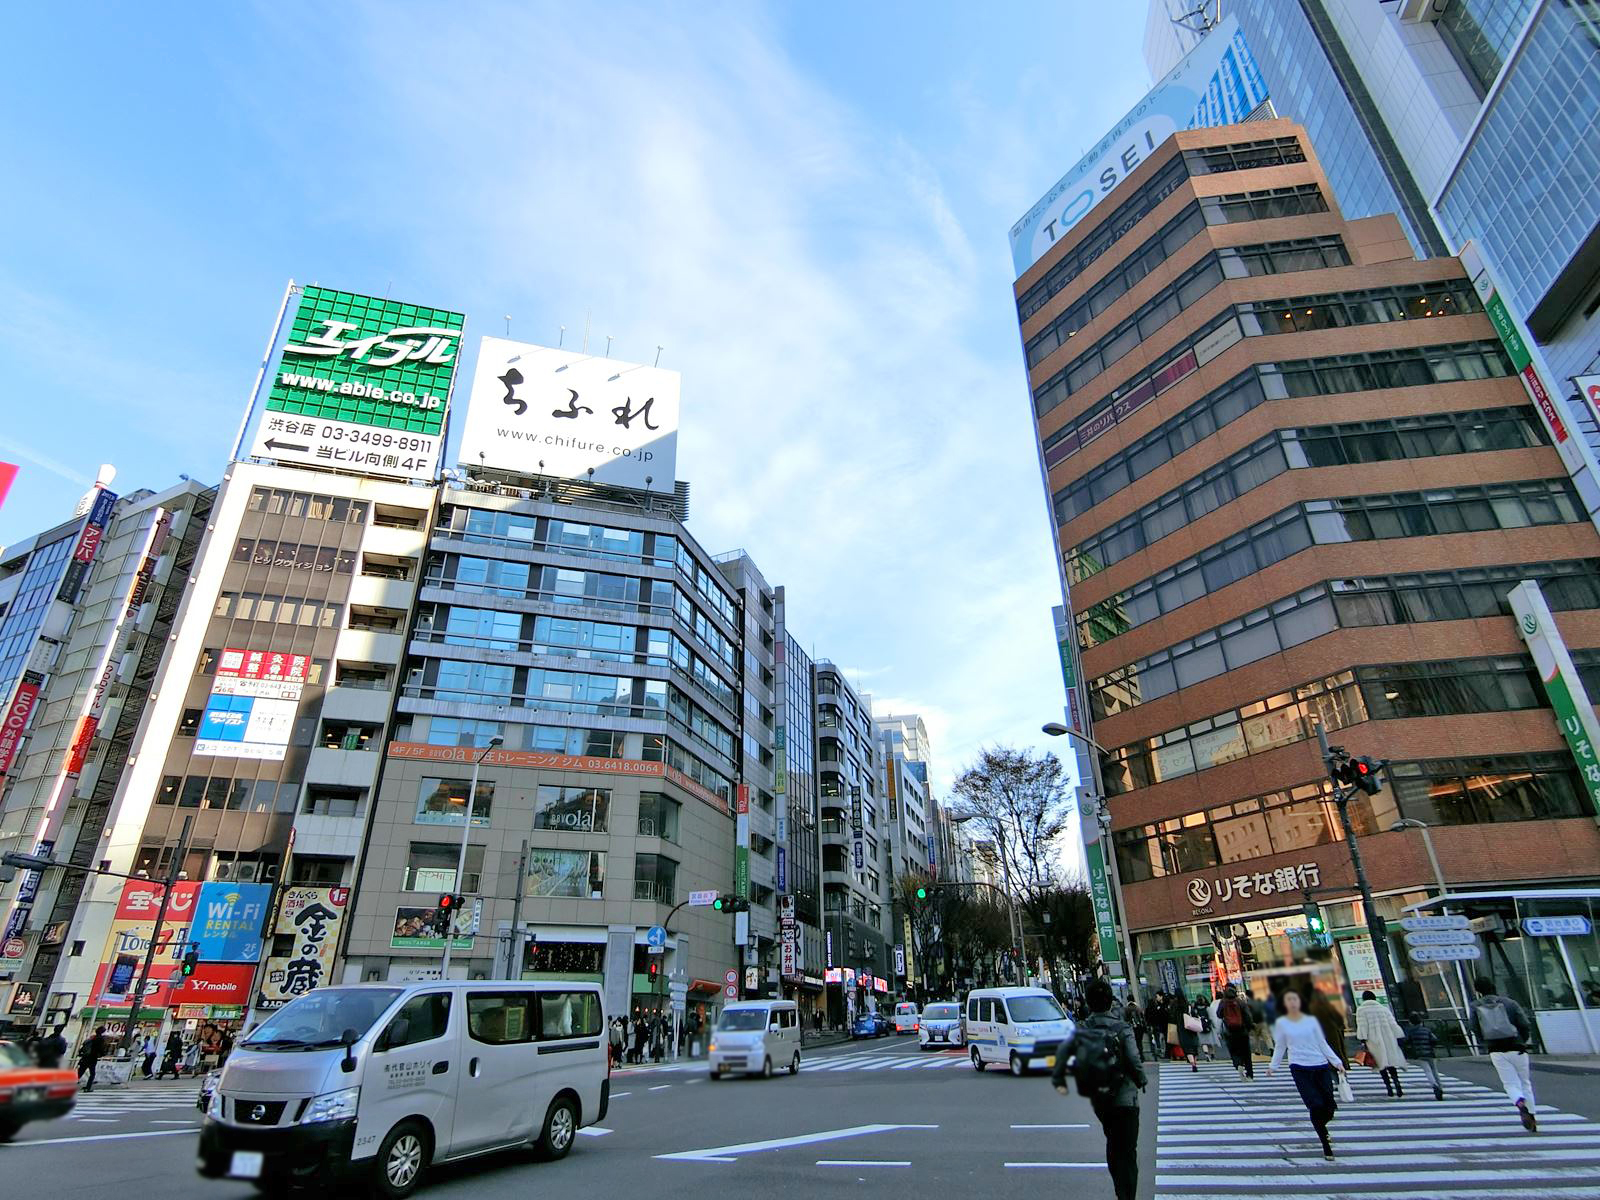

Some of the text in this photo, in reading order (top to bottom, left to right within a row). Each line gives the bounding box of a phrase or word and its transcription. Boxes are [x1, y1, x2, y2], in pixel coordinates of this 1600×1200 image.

[1043, 130, 1156, 243] TOSEI
[283, 319, 461, 366] エイブル
[280, 370, 440, 410] www.able.co.jp
[497, 368, 659, 430] ちふれ
[267, 416, 432, 454] 渋谷店 03-3499-8911
[1080, 401, 1131, 441] 三井のリハウス
[316, 444, 428, 472] 当ビル向側 4F
[497, 426, 653, 462] www.chifure.co.jp
[77, 526, 100, 559] アビバ
[588, 758, 659, 774] 03.6418.0064
[288, 891, 318, 899] きんくら
[332, 889, 348, 902] 1F
[1215, 862, 1320, 902] りそな銀行
[126, 890, 192, 912] 宝くじ
[208, 902, 260, 919] Wi-Fi
[1092, 868, 1113, 938] りそな銀行
[206, 920, 253, 930] RENTAL
[244, 943, 257, 951] 2F
[280, 902, 338, 996] 金の蔵
[784, 944, 793, 974] お弁当
[191, 979, 237, 991] Y!mobile
